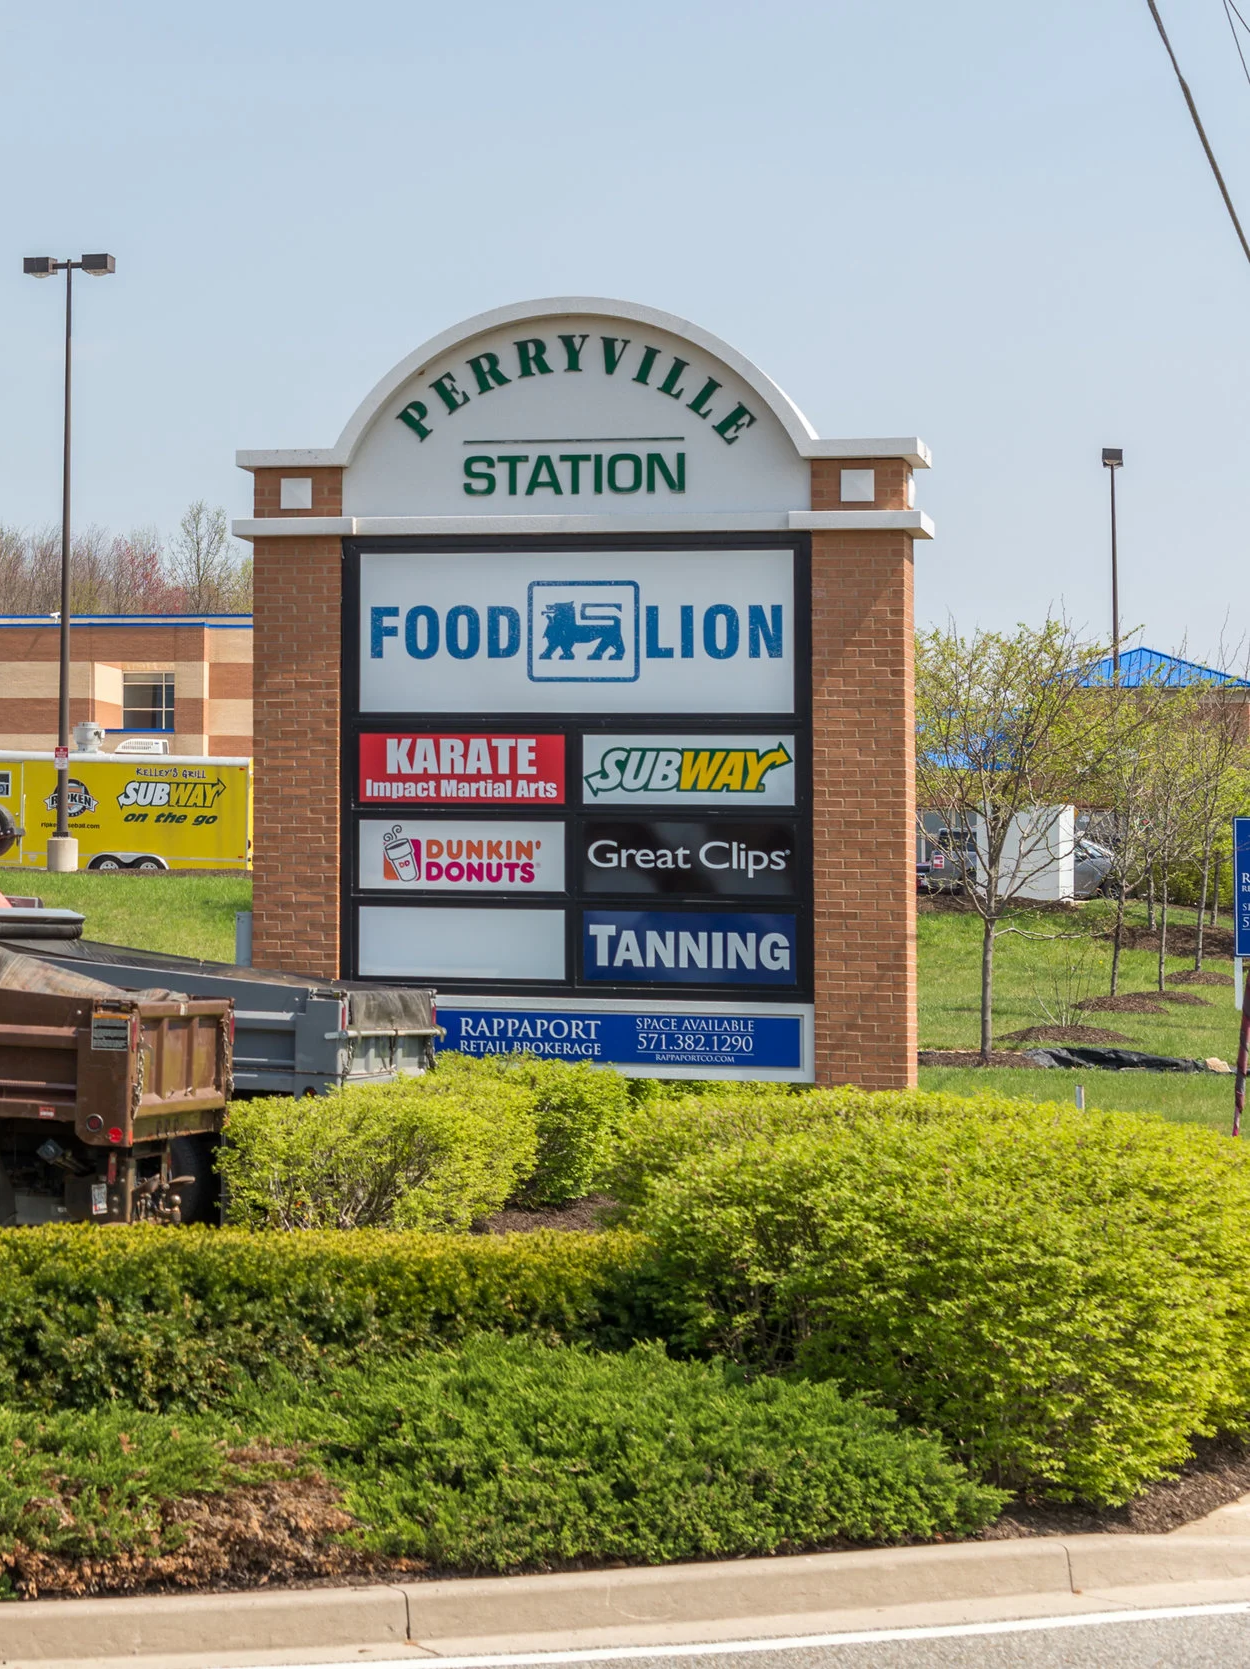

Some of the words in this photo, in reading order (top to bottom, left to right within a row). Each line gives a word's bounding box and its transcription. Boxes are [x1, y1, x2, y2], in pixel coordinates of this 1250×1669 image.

[396, 333, 758, 446] PERRYVILLE
[462, 452, 686, 496] STATION
[370, 604, 522, 660] FOOD
[645, 603, 784, 659] LION
[386, 738, 538, 775] KARATE
[136, 767, 178, 778] KELLEY'S
[182, 769, 207, 779] GRILL
[583, 741, 794, 797] SUBWAY
[51, 792, 91, 807] RKEN
[116, 777, 227, 811] SUBWAY
[366, 779, 437, 799] Impact
[440, 779, 512, 798] Martial
[516, 780, 558, 798] Arts
[123, 812, 149, 823] on
[154, 812, 188, 824] the
[192, 814, 218, 826] go
[425, 839, 542, 861] DUNKIN'
[587, 839, 692, 869] Great
[699, 841, 787, 878] Clips
[425, 861, 535, 883] DONUTS
[589, 924, 791, 971] TANNING
[459, 1017, 602, 1040] RAPPAPORT
[636, 1018, 677, 1030] SPACE
[681, 1020, 755, 1032] AVAILABLE
[459, 1040, 509, 1053] RETAIL
[513, 1042, 602, 1056] BROKERAGE
[637, 1033, 754, 1052] 571.382.1290
[655, 1053, 735, 1063] RAPPAPORTCO.COM
